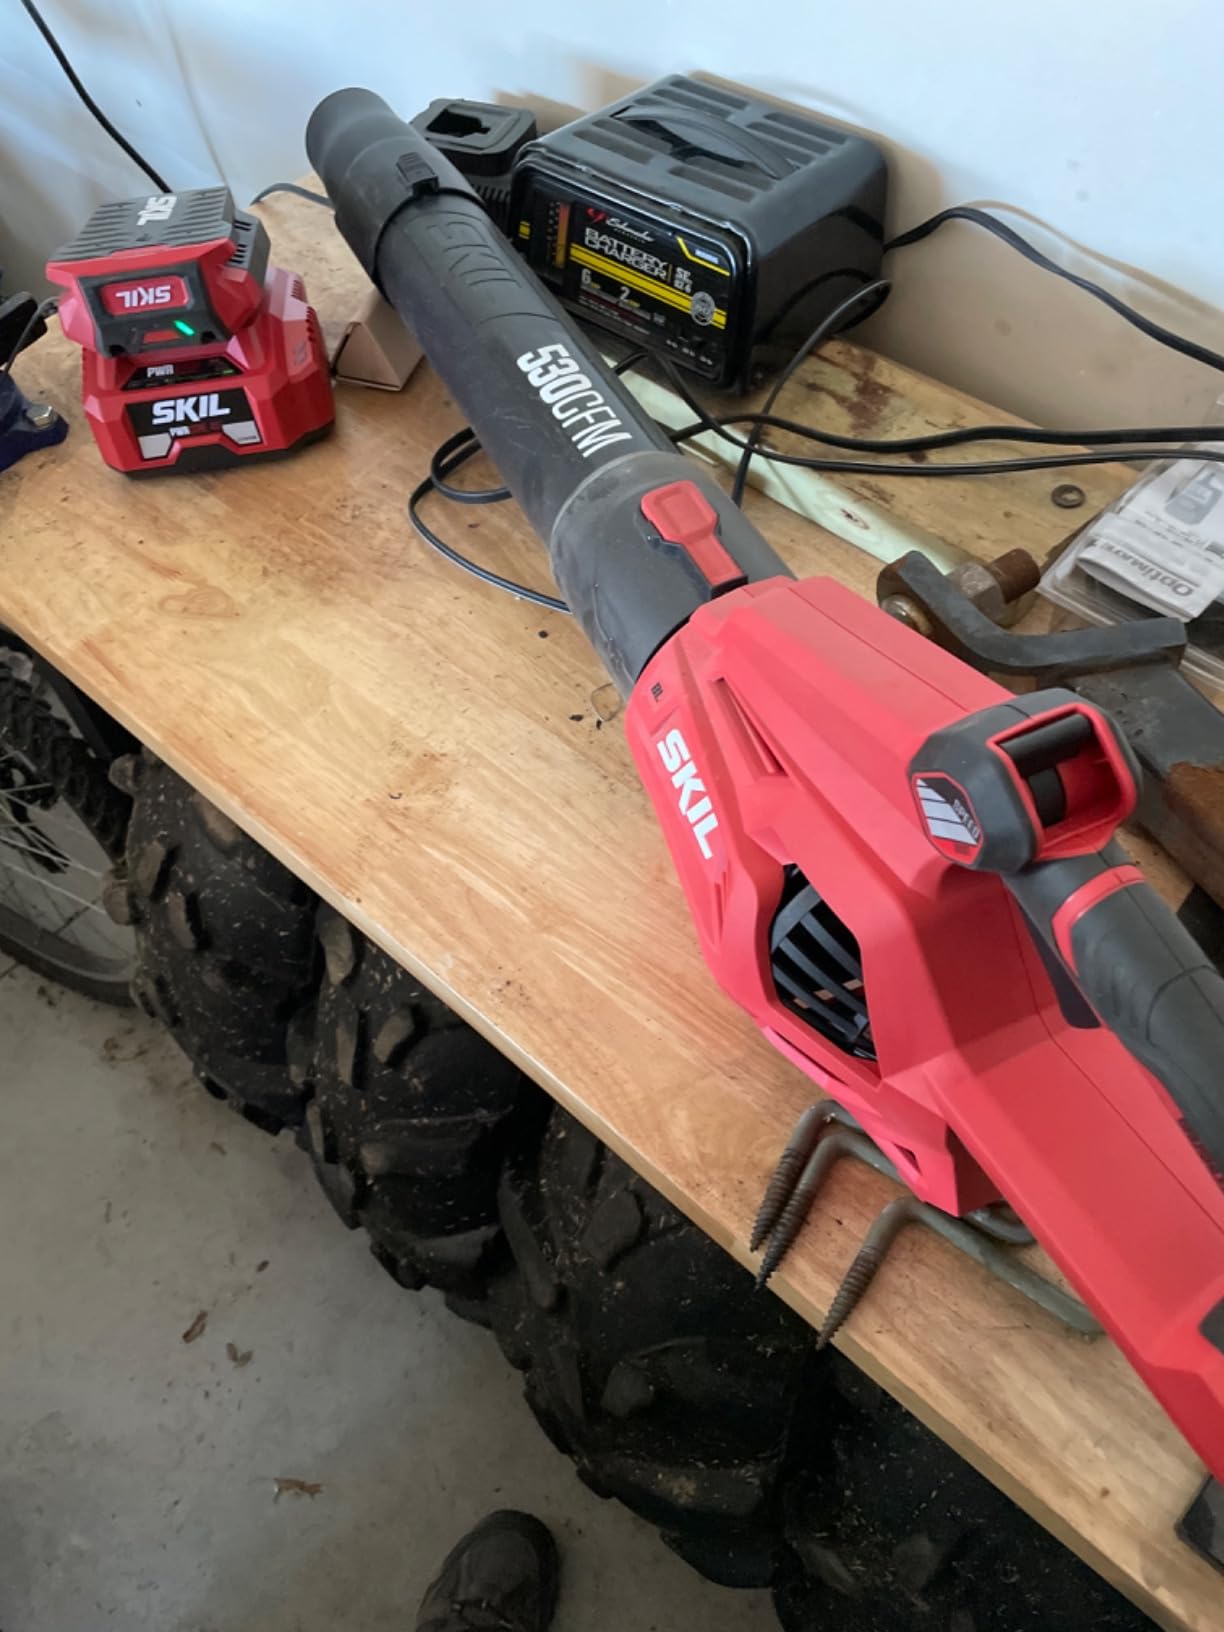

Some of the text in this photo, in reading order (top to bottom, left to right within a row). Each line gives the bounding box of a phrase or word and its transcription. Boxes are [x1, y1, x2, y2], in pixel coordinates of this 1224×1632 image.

[585, 227, 669, 270] BATTERY
[581, 269, 591, 285] 6
[619, 287, 630, 300] 2
[115, 285, 172, 308] SKIL
[152, 393, 231, 426] SKIL
[516, 343, 633, 458] 530CFM
[656, 728, 720, 861] SKIL
